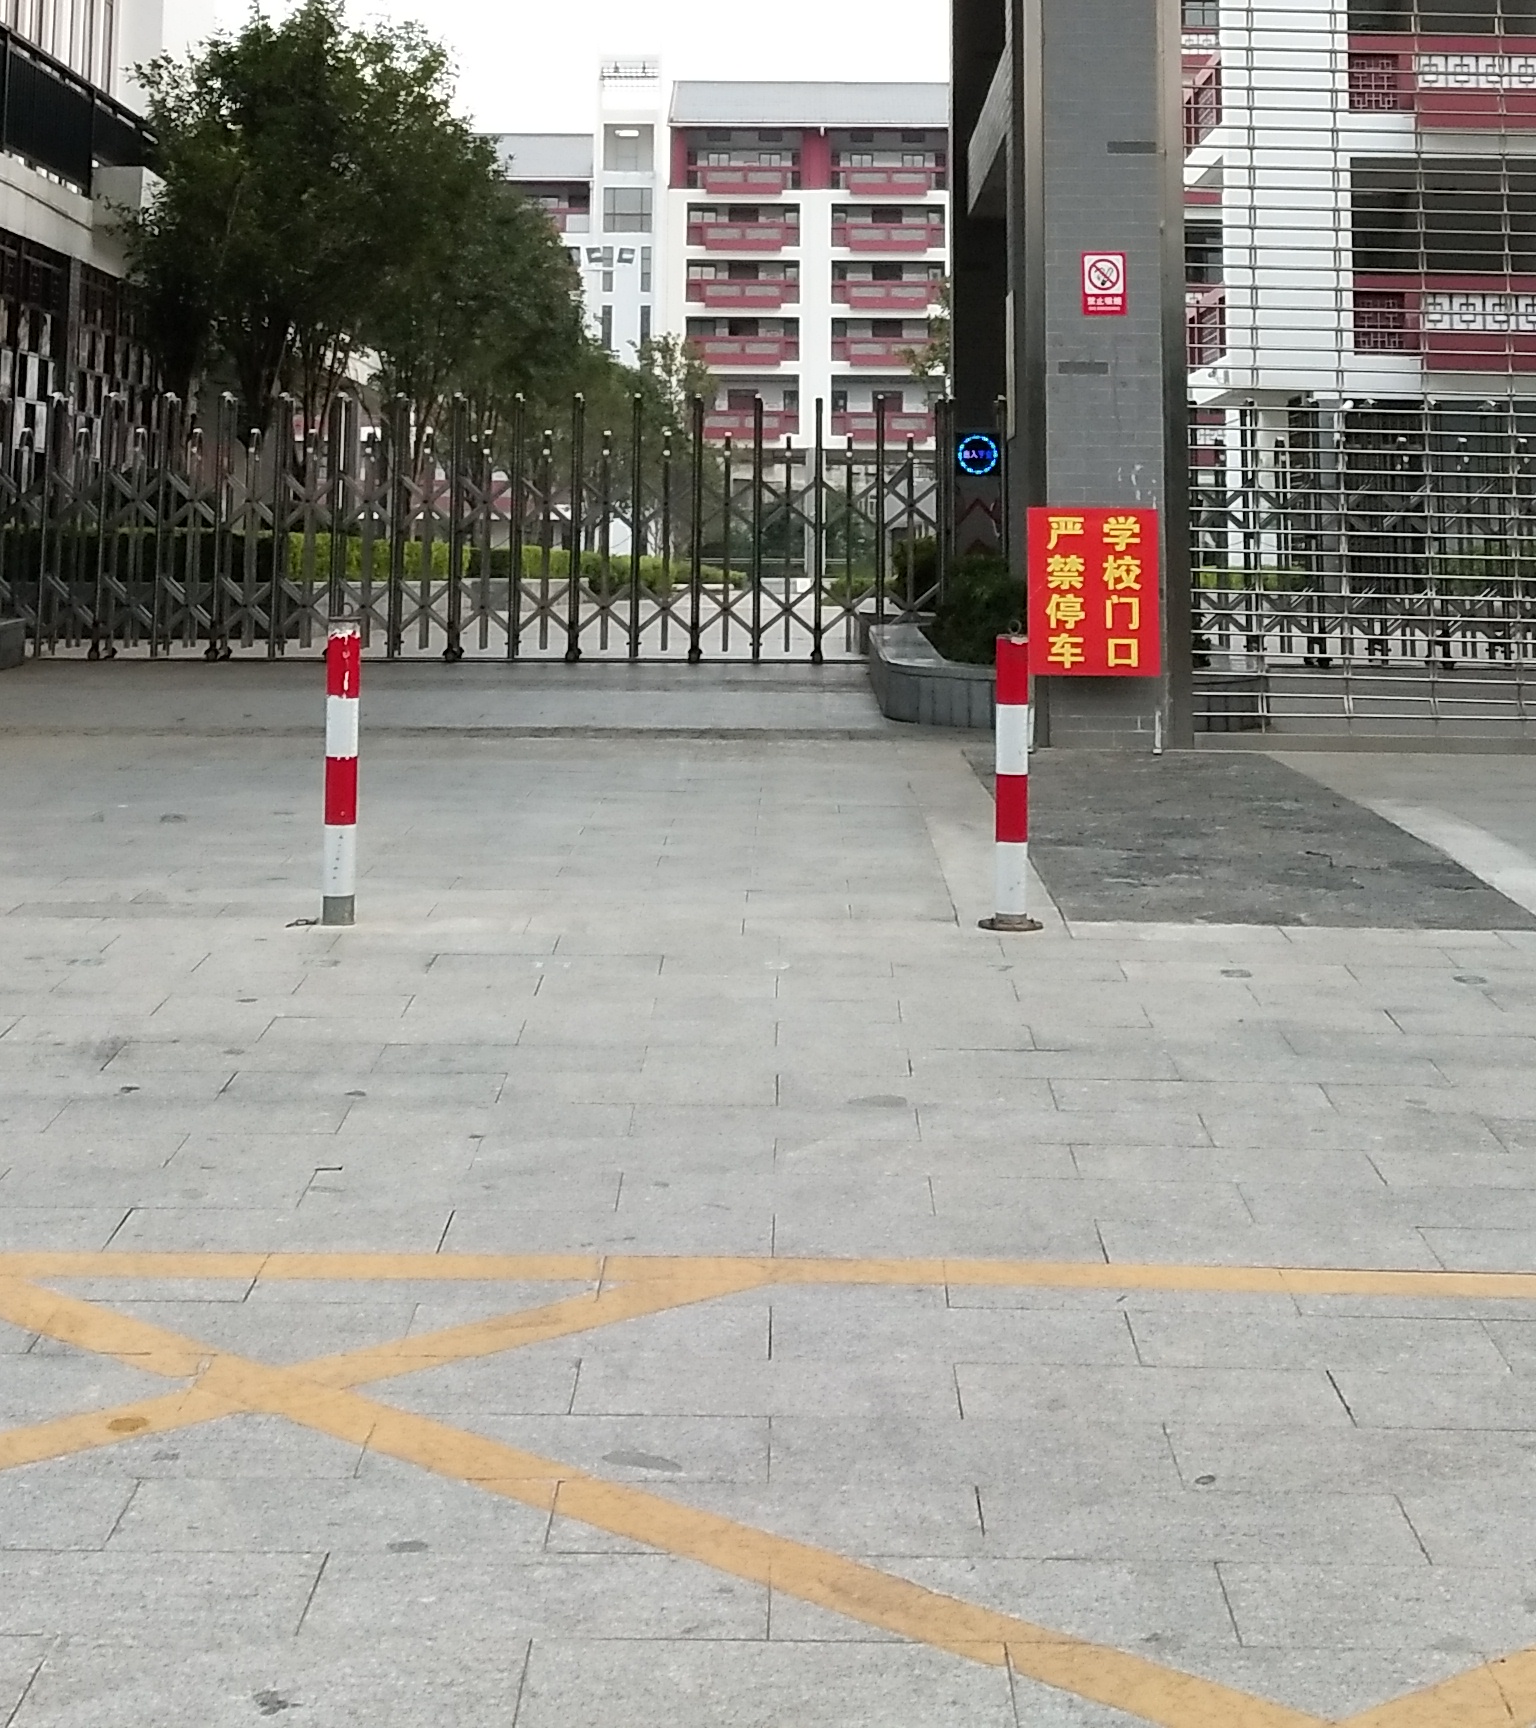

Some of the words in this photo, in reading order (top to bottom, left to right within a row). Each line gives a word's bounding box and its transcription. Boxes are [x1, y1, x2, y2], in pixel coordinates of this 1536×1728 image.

[1045, 516, 1086, 669] 严禁停车
[1102, 516, 1142, 668] 学校门口
